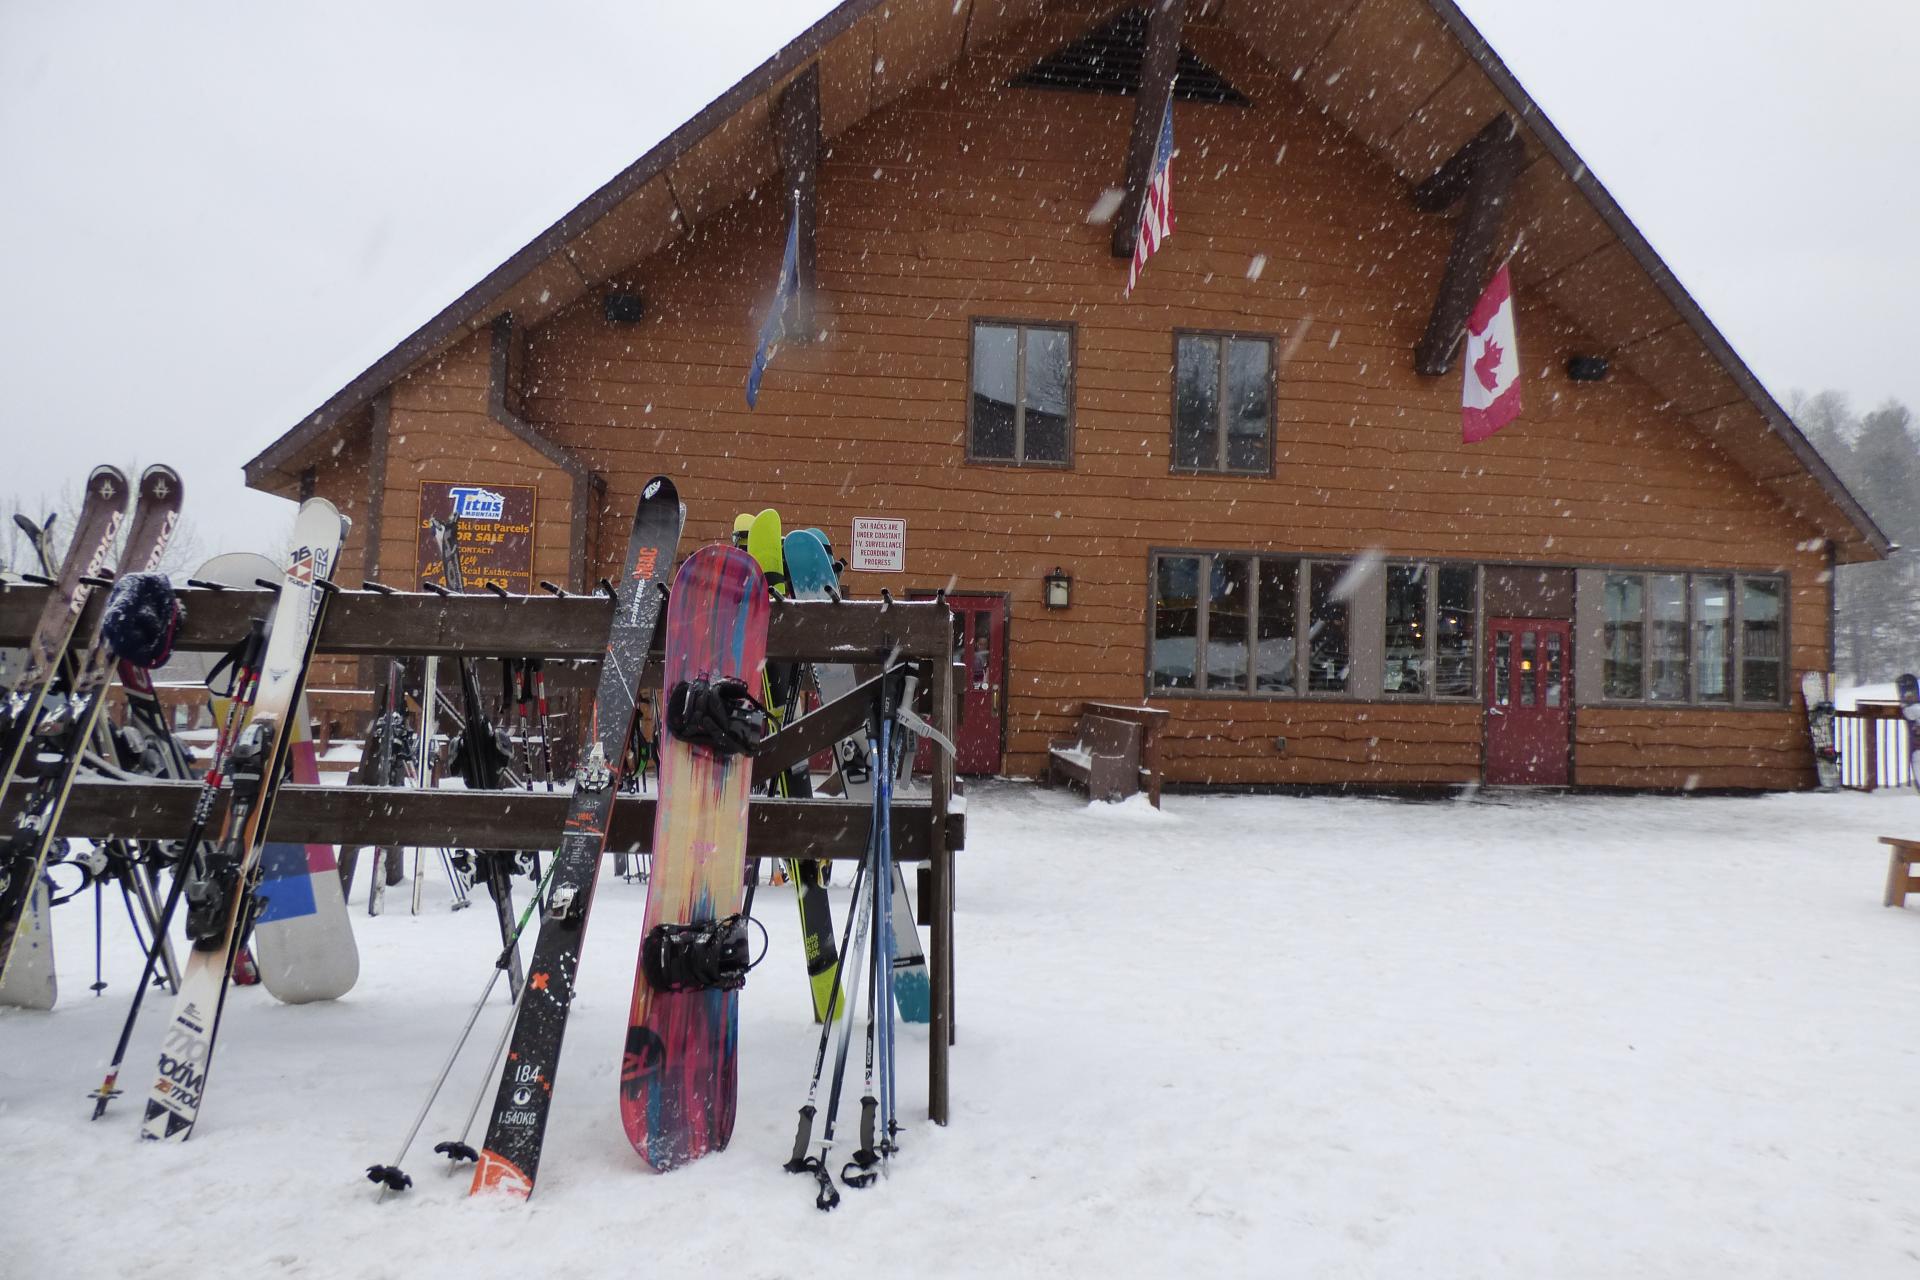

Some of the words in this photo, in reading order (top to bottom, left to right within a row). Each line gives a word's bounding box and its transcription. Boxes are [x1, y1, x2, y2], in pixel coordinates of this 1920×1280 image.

[452, 489, 501, 514] Titus
[494, 523, 529, 534] Parcels
[860, 522, 869, 530] SKI
[870, 522, 887, 530] RACKS
[475, 532, 504, 543] SALE
[856, 531, 873, 539] UNDER
[874, 532, 901, 540] CONSTANT
[865, 540, 902, 548] SURVEILLANCE
[864, 558, 892, 566] PROGRESS
[515, 1064, 542, 1083] 184
